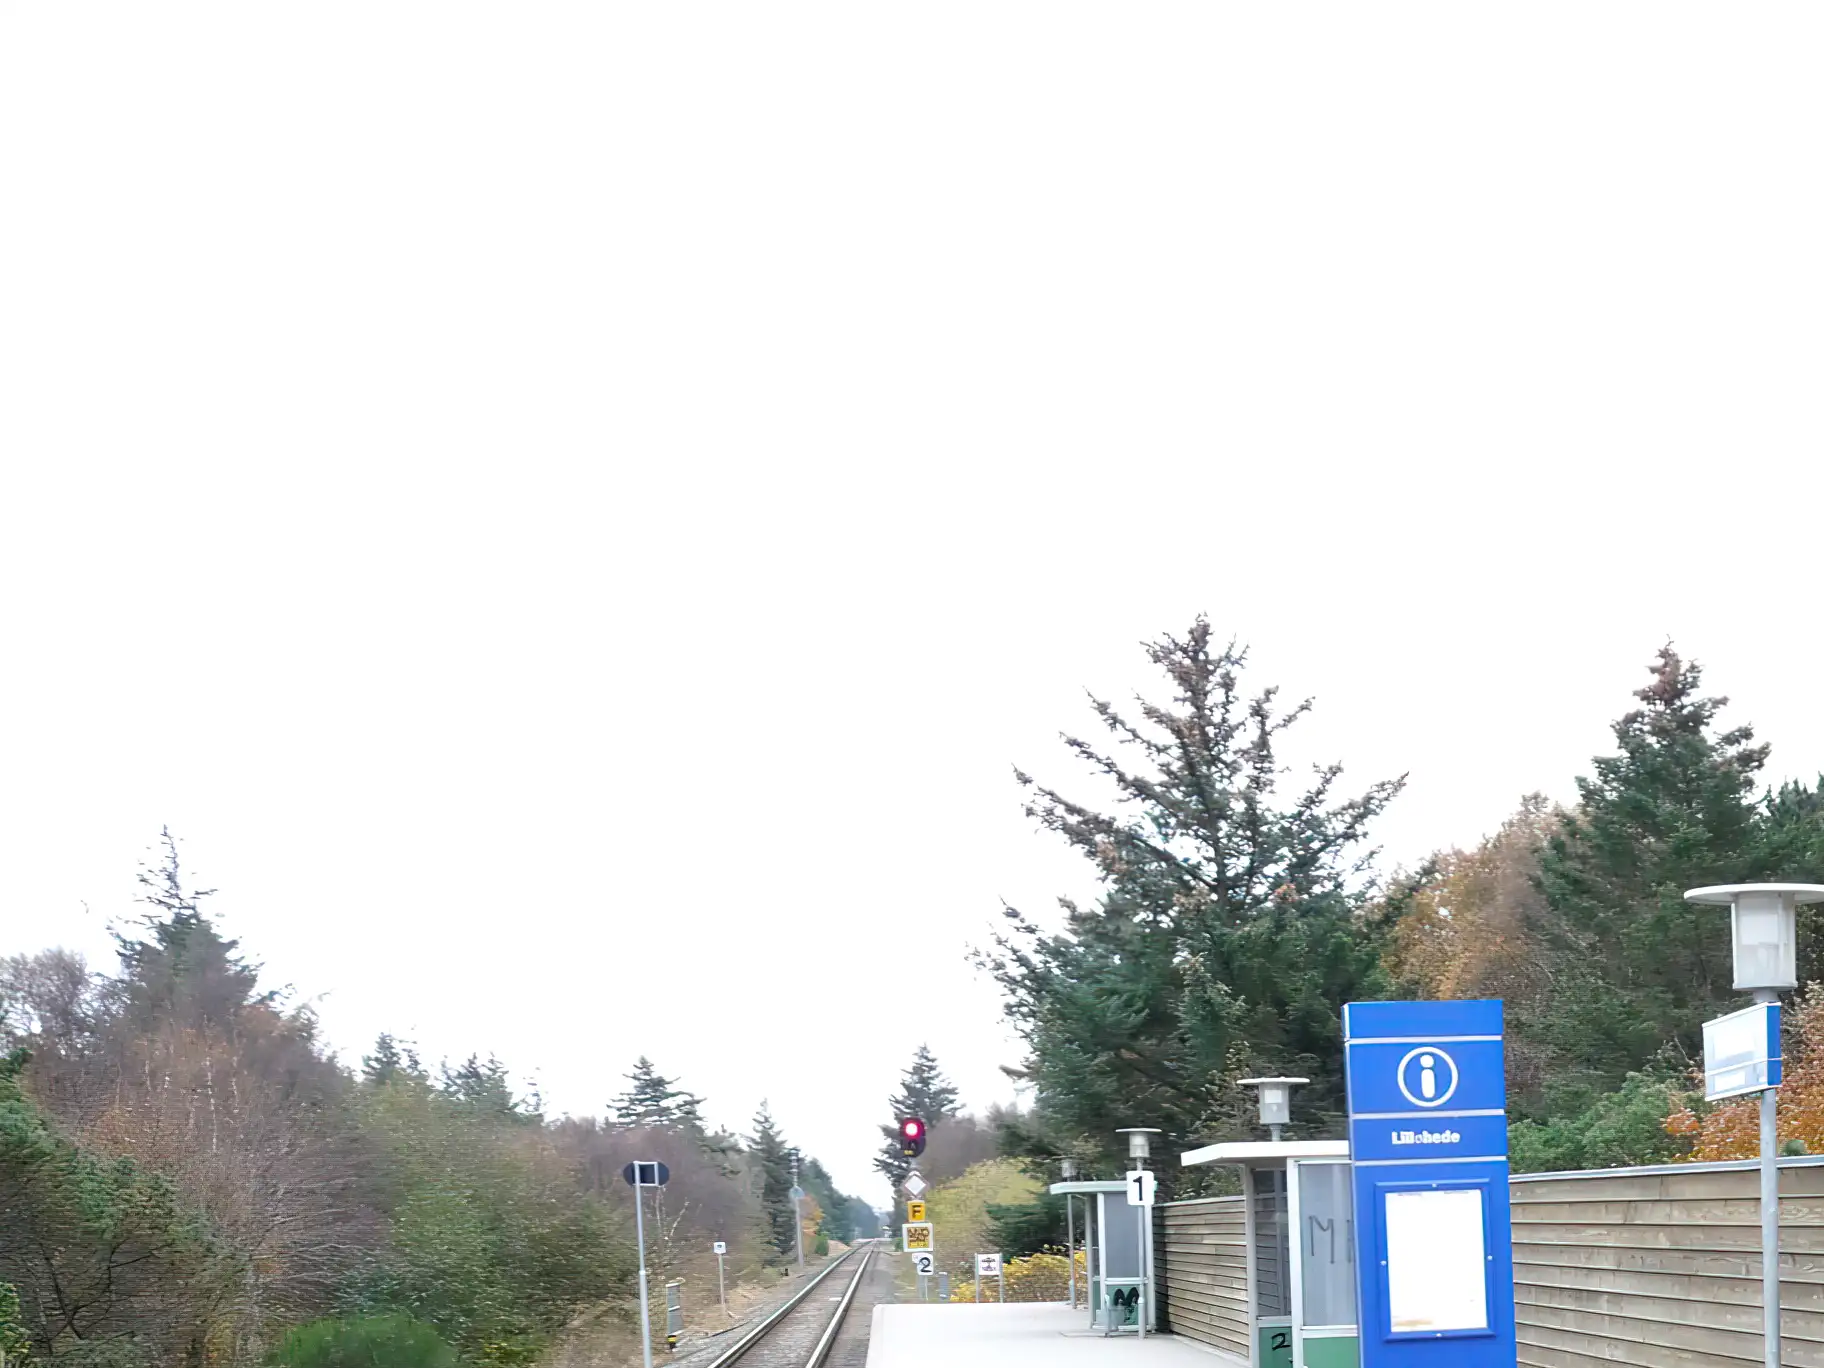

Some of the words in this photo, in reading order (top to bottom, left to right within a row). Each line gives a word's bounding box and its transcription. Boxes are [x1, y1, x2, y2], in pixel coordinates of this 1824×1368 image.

[1132, 1175, 1144, 1202] 1
[919, 1256, 932, 1274] 2
[1271, 1332, 1291, 1352] 2
